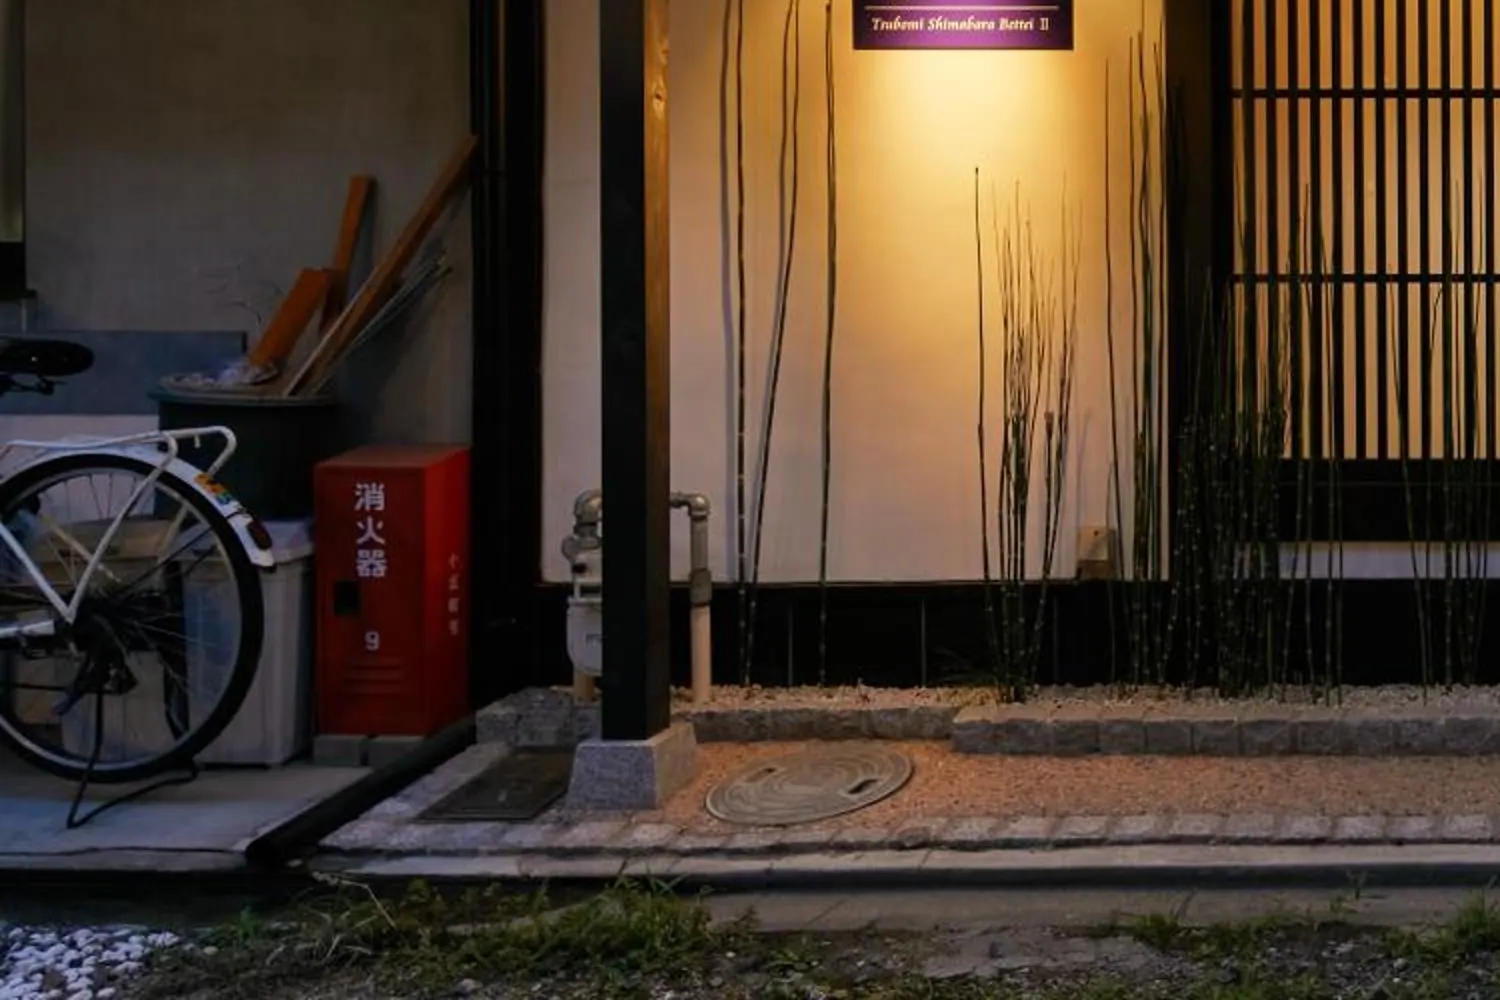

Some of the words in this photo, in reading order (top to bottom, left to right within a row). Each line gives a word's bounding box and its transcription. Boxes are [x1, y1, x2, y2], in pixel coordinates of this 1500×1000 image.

[872, 15, 924, 32] Tsubomi
[927, 15, 995, 32] Shimabara
[999, 17, 1034, 31] Bettei
[354, 482, 387, 578] 消火器
[364, 630, 380, 651] 9
